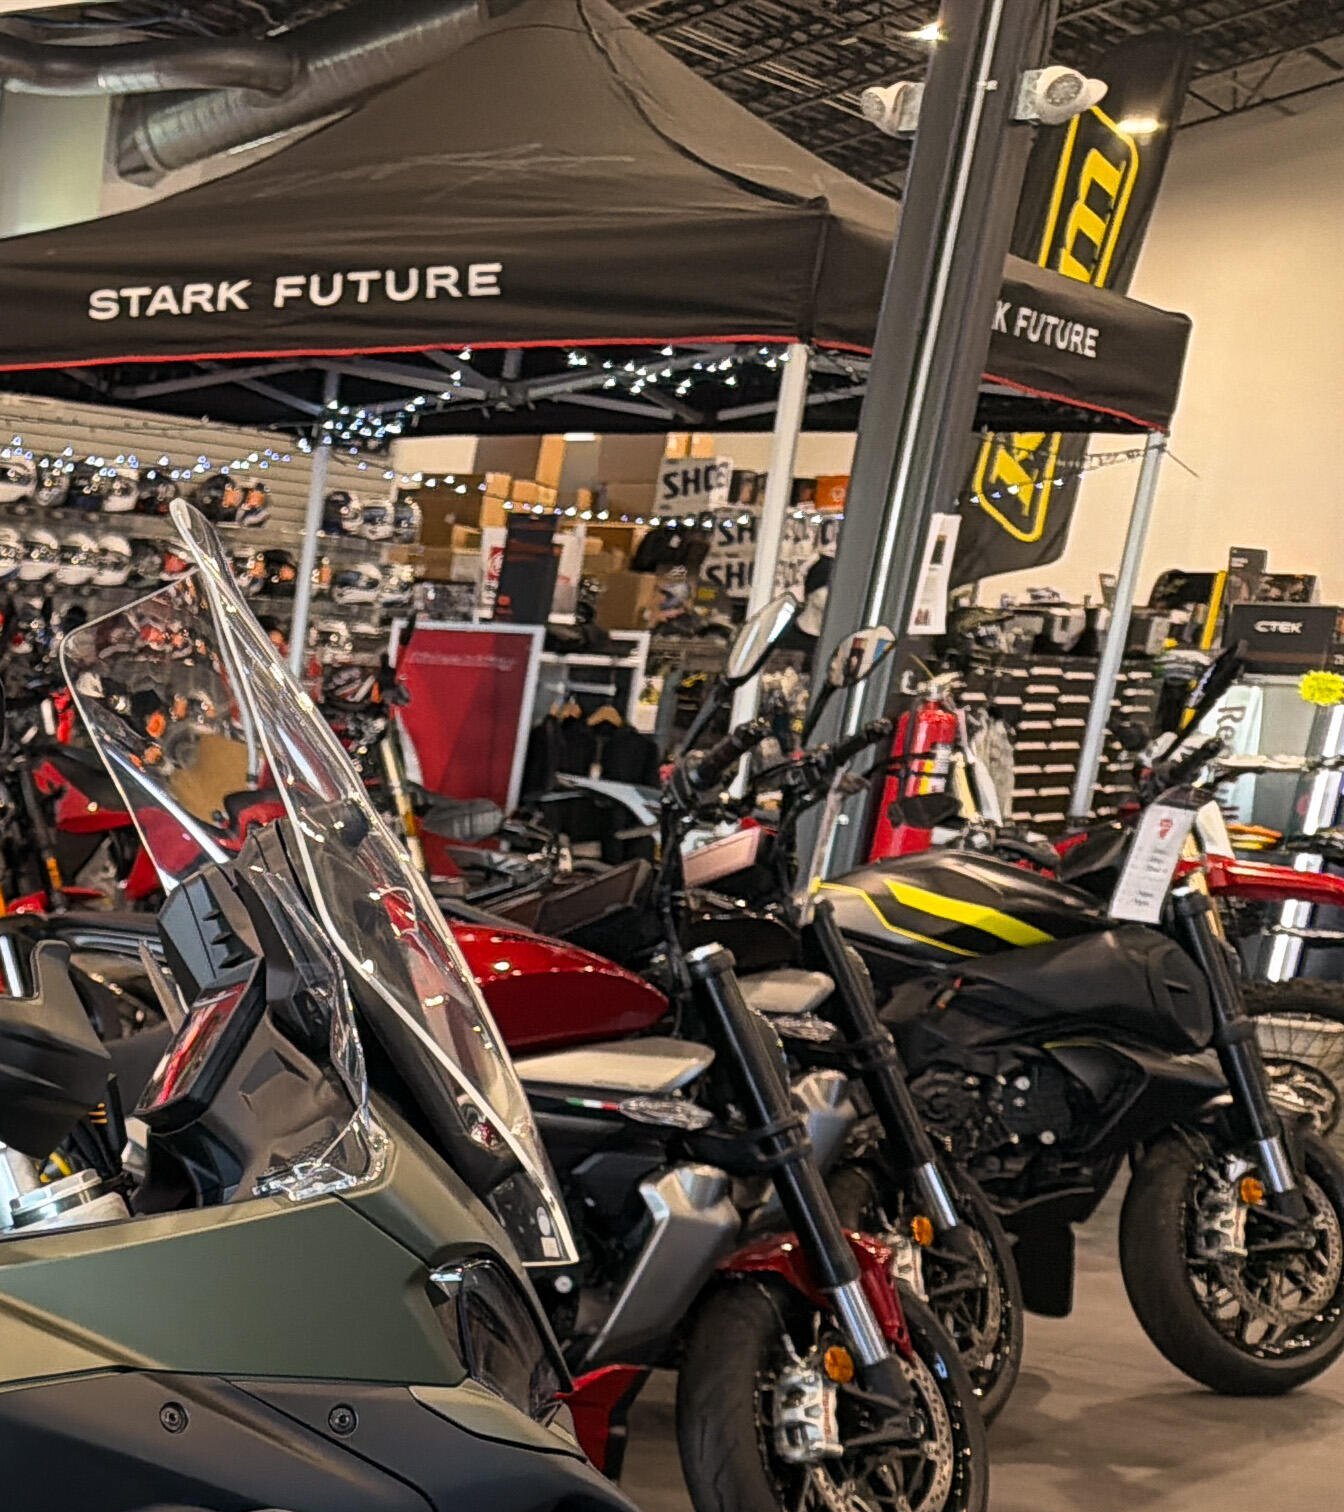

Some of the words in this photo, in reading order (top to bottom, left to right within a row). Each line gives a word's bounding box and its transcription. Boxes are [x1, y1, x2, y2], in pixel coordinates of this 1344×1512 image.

[88, 280, 253, 320] STARK
[273, 262, 503, 309] FUTURE
[1013, 306, 1100, 358] FUTURE
[1254, 619, 1304, 635] CTEK
